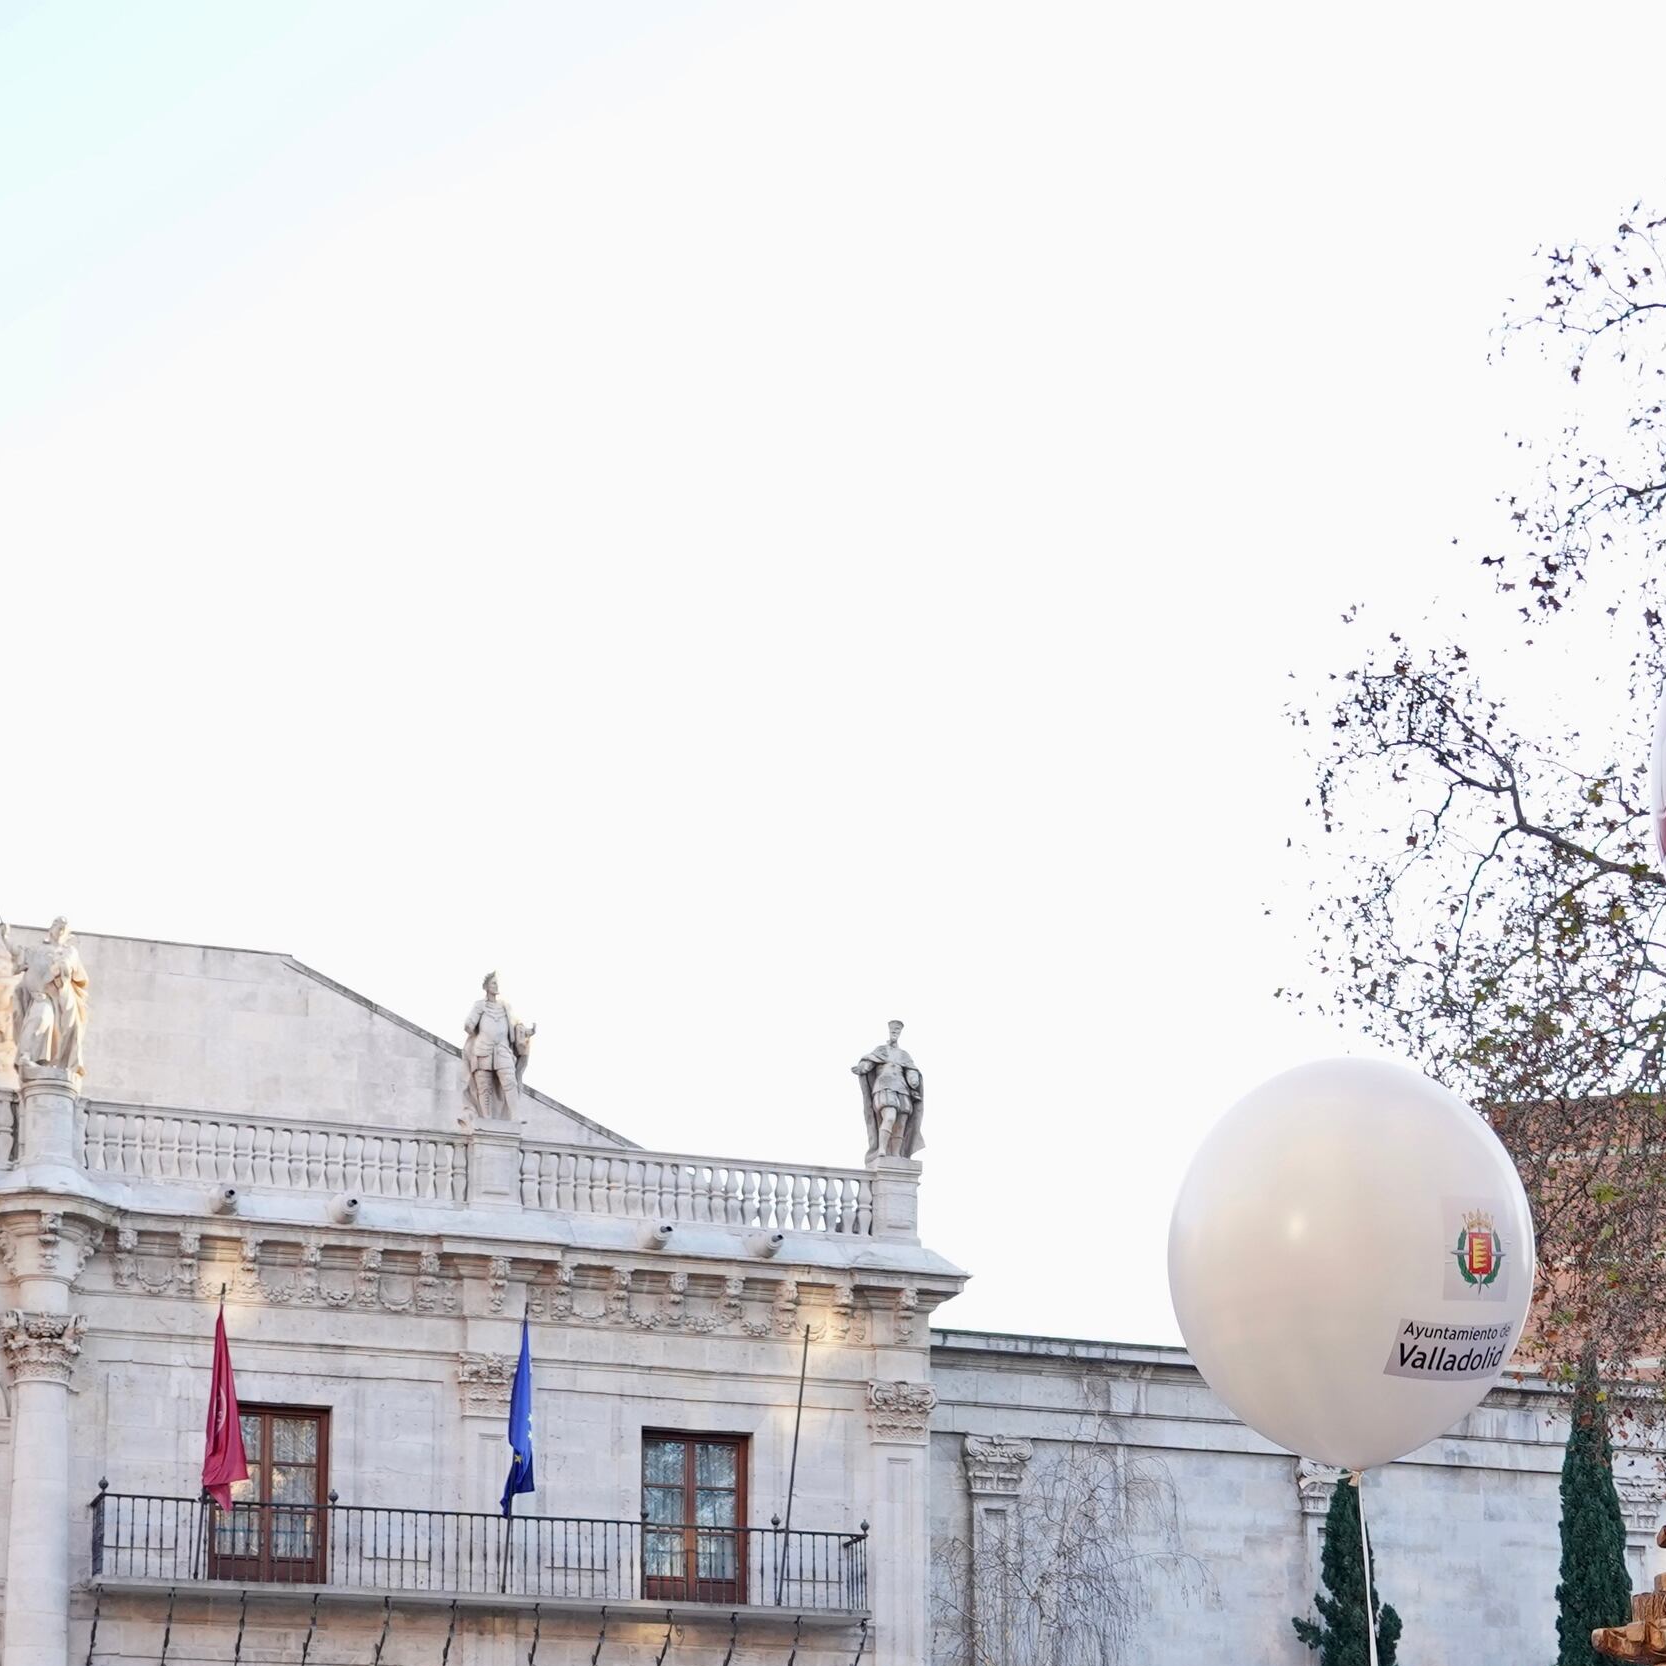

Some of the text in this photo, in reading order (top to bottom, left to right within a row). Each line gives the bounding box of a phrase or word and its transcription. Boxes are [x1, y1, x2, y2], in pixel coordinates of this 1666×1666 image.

[1403, 1321, 1511, 1341] Ayuntamiento de
[1399, 1342, 1506, 1371] Valladolid
